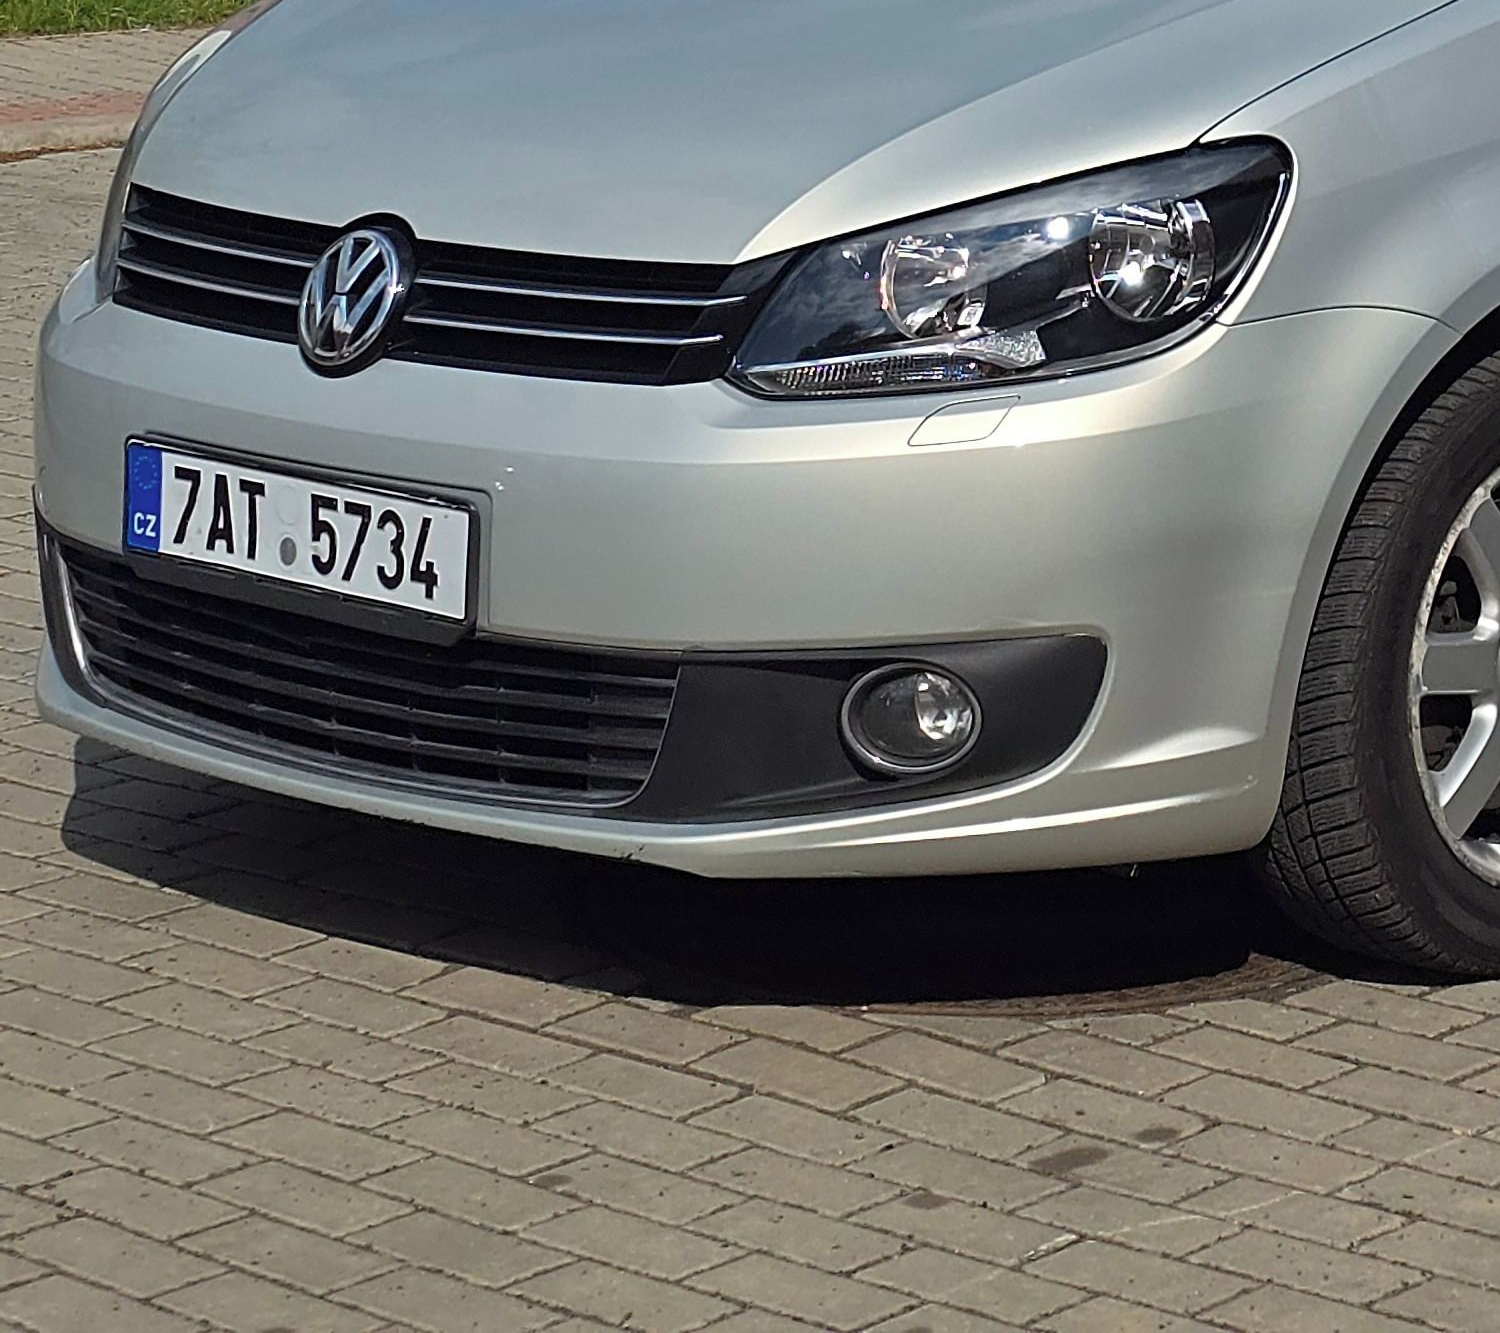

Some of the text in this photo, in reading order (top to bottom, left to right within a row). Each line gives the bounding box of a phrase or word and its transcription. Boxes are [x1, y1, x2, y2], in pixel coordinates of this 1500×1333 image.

[298, 229, 399, 366] VW
[133, 512, 157, 537] CZ
[172, 465, 439, 600] 7AT 5734
